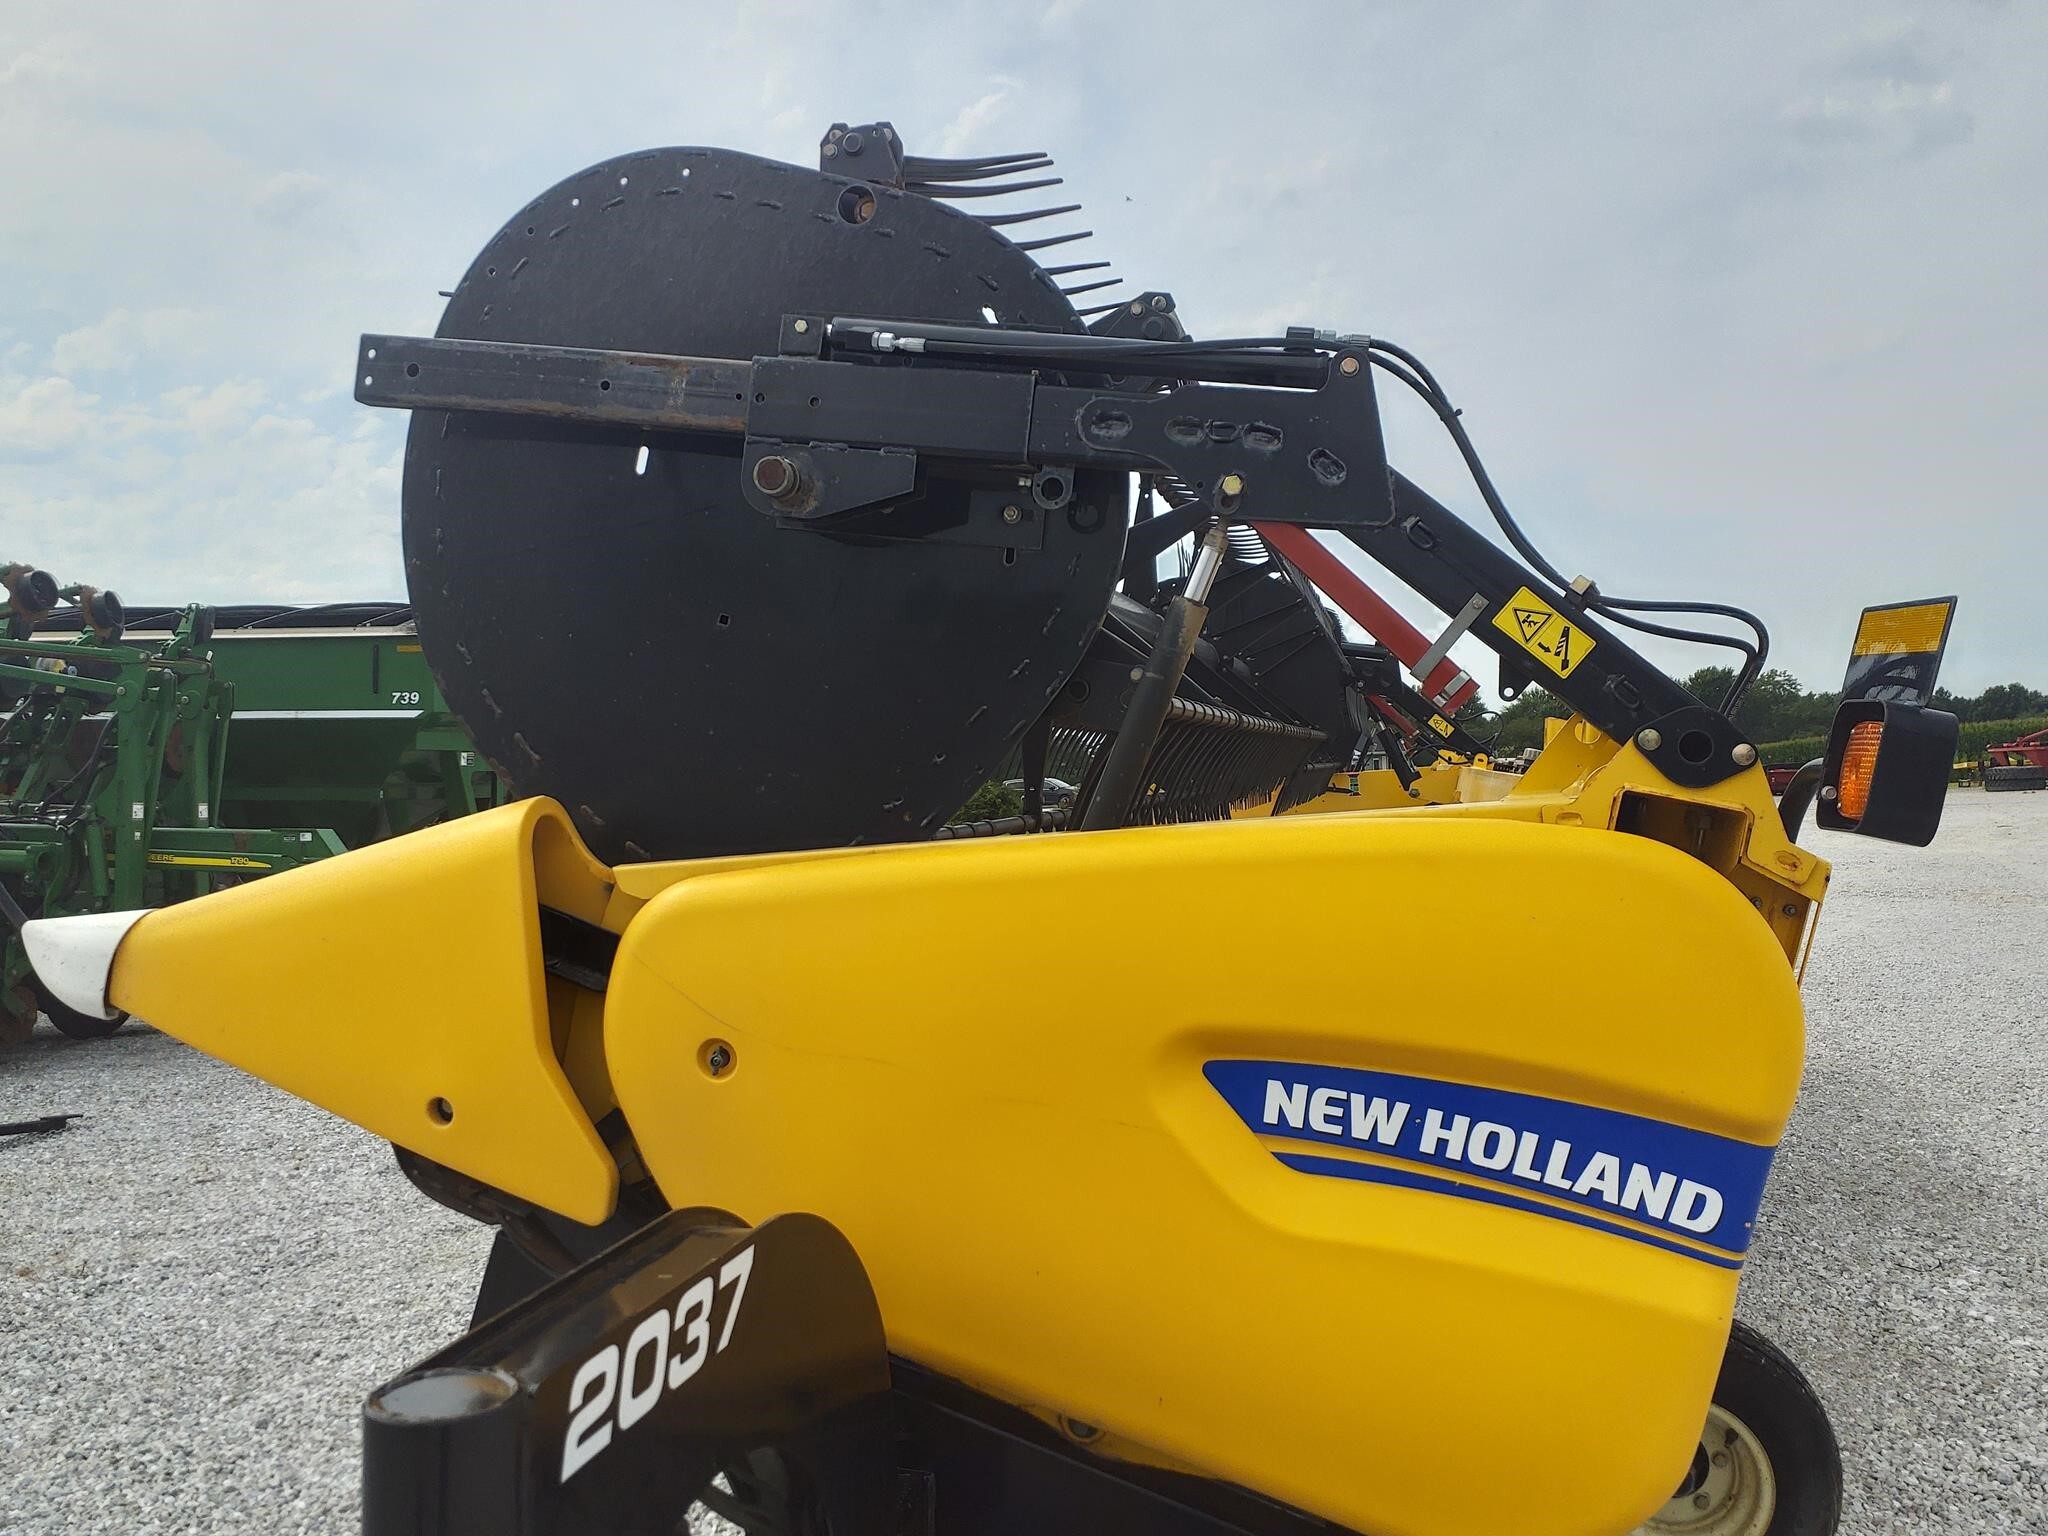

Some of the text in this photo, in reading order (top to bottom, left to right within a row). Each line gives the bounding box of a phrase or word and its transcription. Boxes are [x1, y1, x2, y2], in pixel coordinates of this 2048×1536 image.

[391, 691, 420, 704] 739
[150, 853, 175, 861] EERE
[1263, 1079, 1724, 1234] NEW HOLLAND
[560, 1243, 756, 1484] 2037
